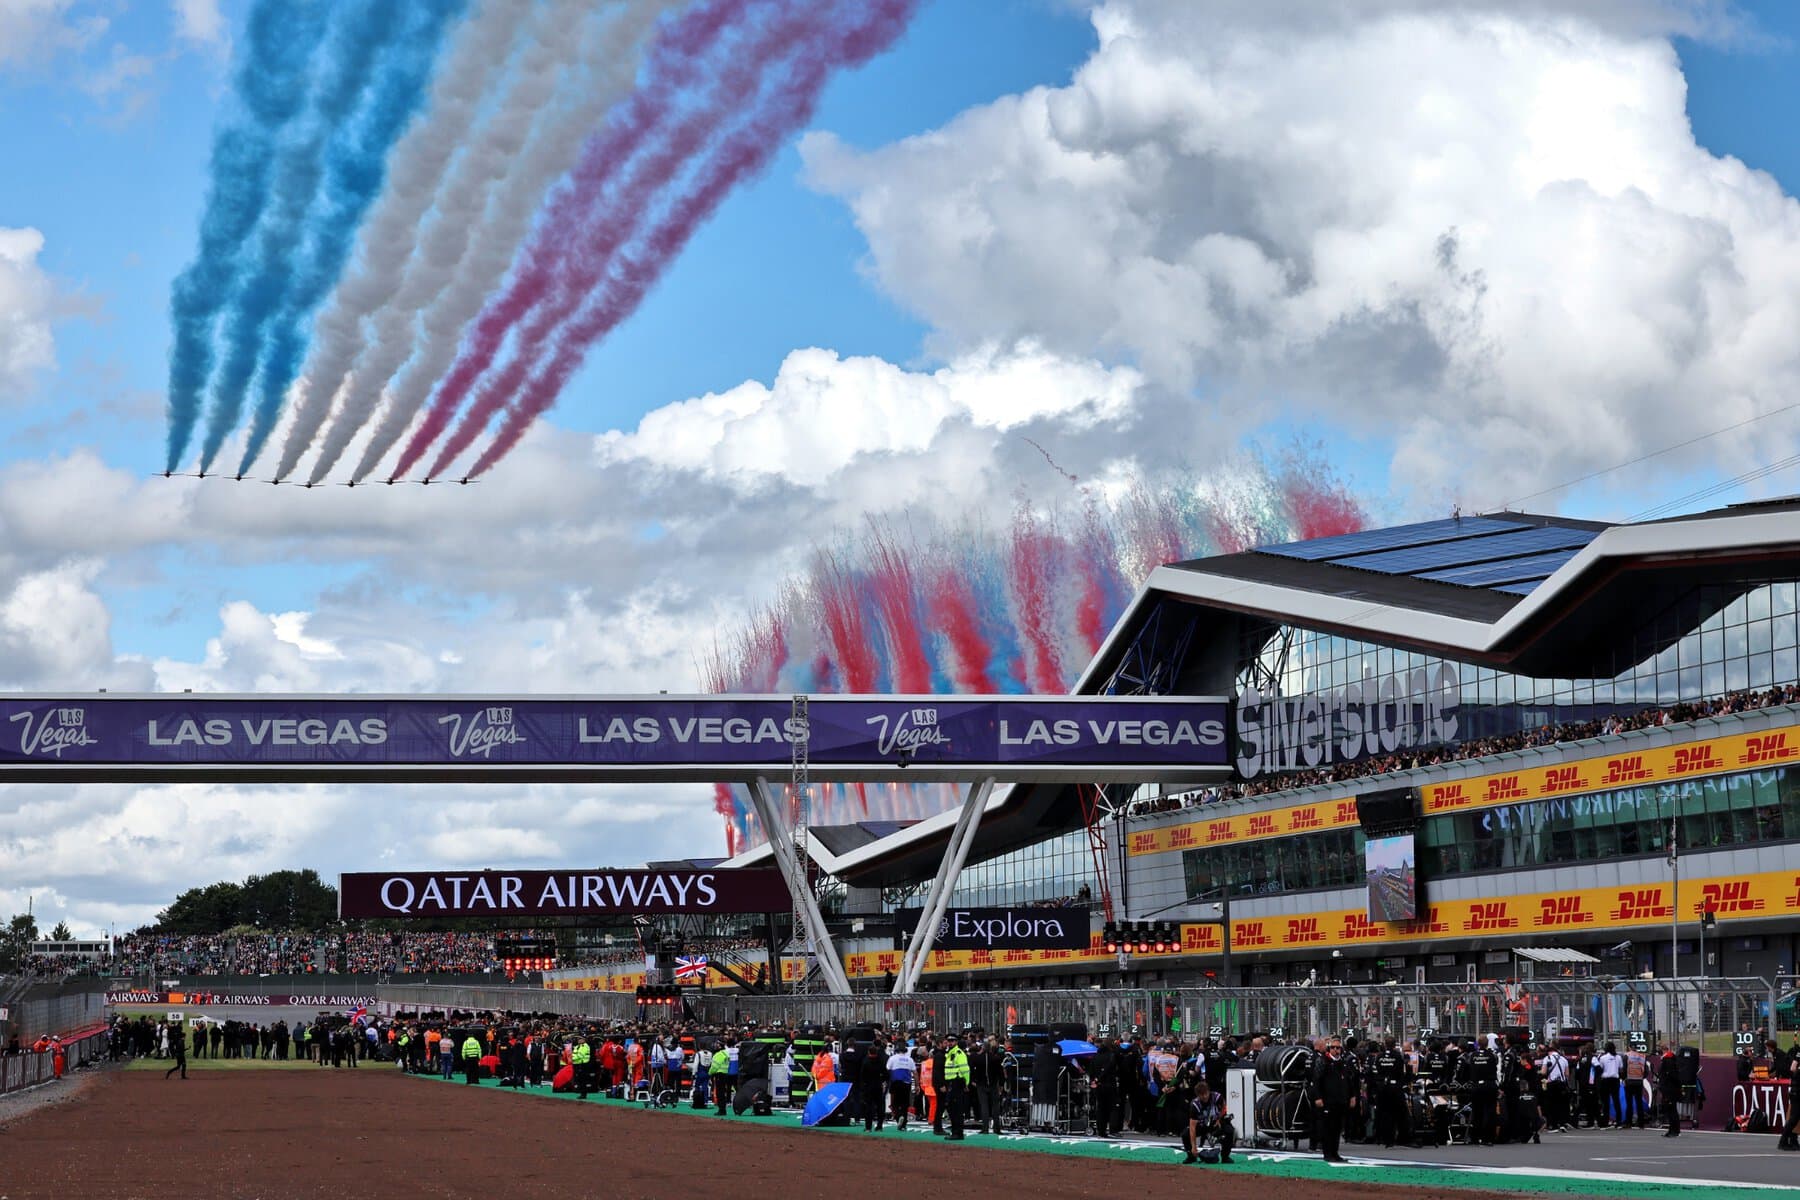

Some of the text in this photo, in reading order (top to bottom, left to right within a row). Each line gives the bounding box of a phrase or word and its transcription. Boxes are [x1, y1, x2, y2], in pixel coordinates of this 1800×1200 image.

[59, 709, 82, 725] LAS
[487, 708, 511, 724] LAS
[914, 710, 936, 724] LAS
[1237, 662, 1459, 779] Silverstone
[10, 711, 97, 757] Vegas
[149, 719, 388, 745] LAS VEGAS
[438, 711, 526, 757] Vegas
[579, 717, 811, 744] LAS VEGAS
[866, 713, 951, 755] Vegas
[1001, 719, 1226, 745] LAS VEGAS
[1674, 745, 1716, 773] DHL
[1746, 733, 1791, 764] DHL
[1545, 766, 1582, 793] DHL
[1606, 756, 1647, 783] DHL
[1432, 785, 1465, 809] DHL
[1487, 776, 1521, 800] DHL
[1248, 815, 1275, 836] DHL
[1291, 808, 1319, 829] DHL
[1134, 833, 1158, 852] DHL
[1170, 828, 1195, 847] DHL
[1208, 821, 1233, 842] DHL
[381, 874, 717, 913] QATAR AIRWAYS
[1618, 889, 1667, 919] DHL
[1702, 881, 1756, 913] DHL
[1469, 903, 1513, 930] DHL
[1539, 896, 1588, 925] DHL
[954, 911, 1064, 945] Explora
[1186, 927, 1216, 948] DHL
[1235, 923, 1267, 946] DHL
[1287, 919, 1321, 943] DHL
[110, 993, 159, 1003] AIRWAYS
[223, 995, 270, 1005] AIRWAYS
[289, 996, 375, 1007] QATAR AIRWAYS
[1099, 1024, 1109, 1032] 16
[1131, 1025, 1138, 1033] 2
[1210, 1026, 1222, 1035] 22
[1270, 1027, 1283, 1036] 24
[1630, 1031, 1646, 1042] 31
[1736, 1033, 1753, 1044] 10
[1733, 1085, 1792, 1127] QATA
